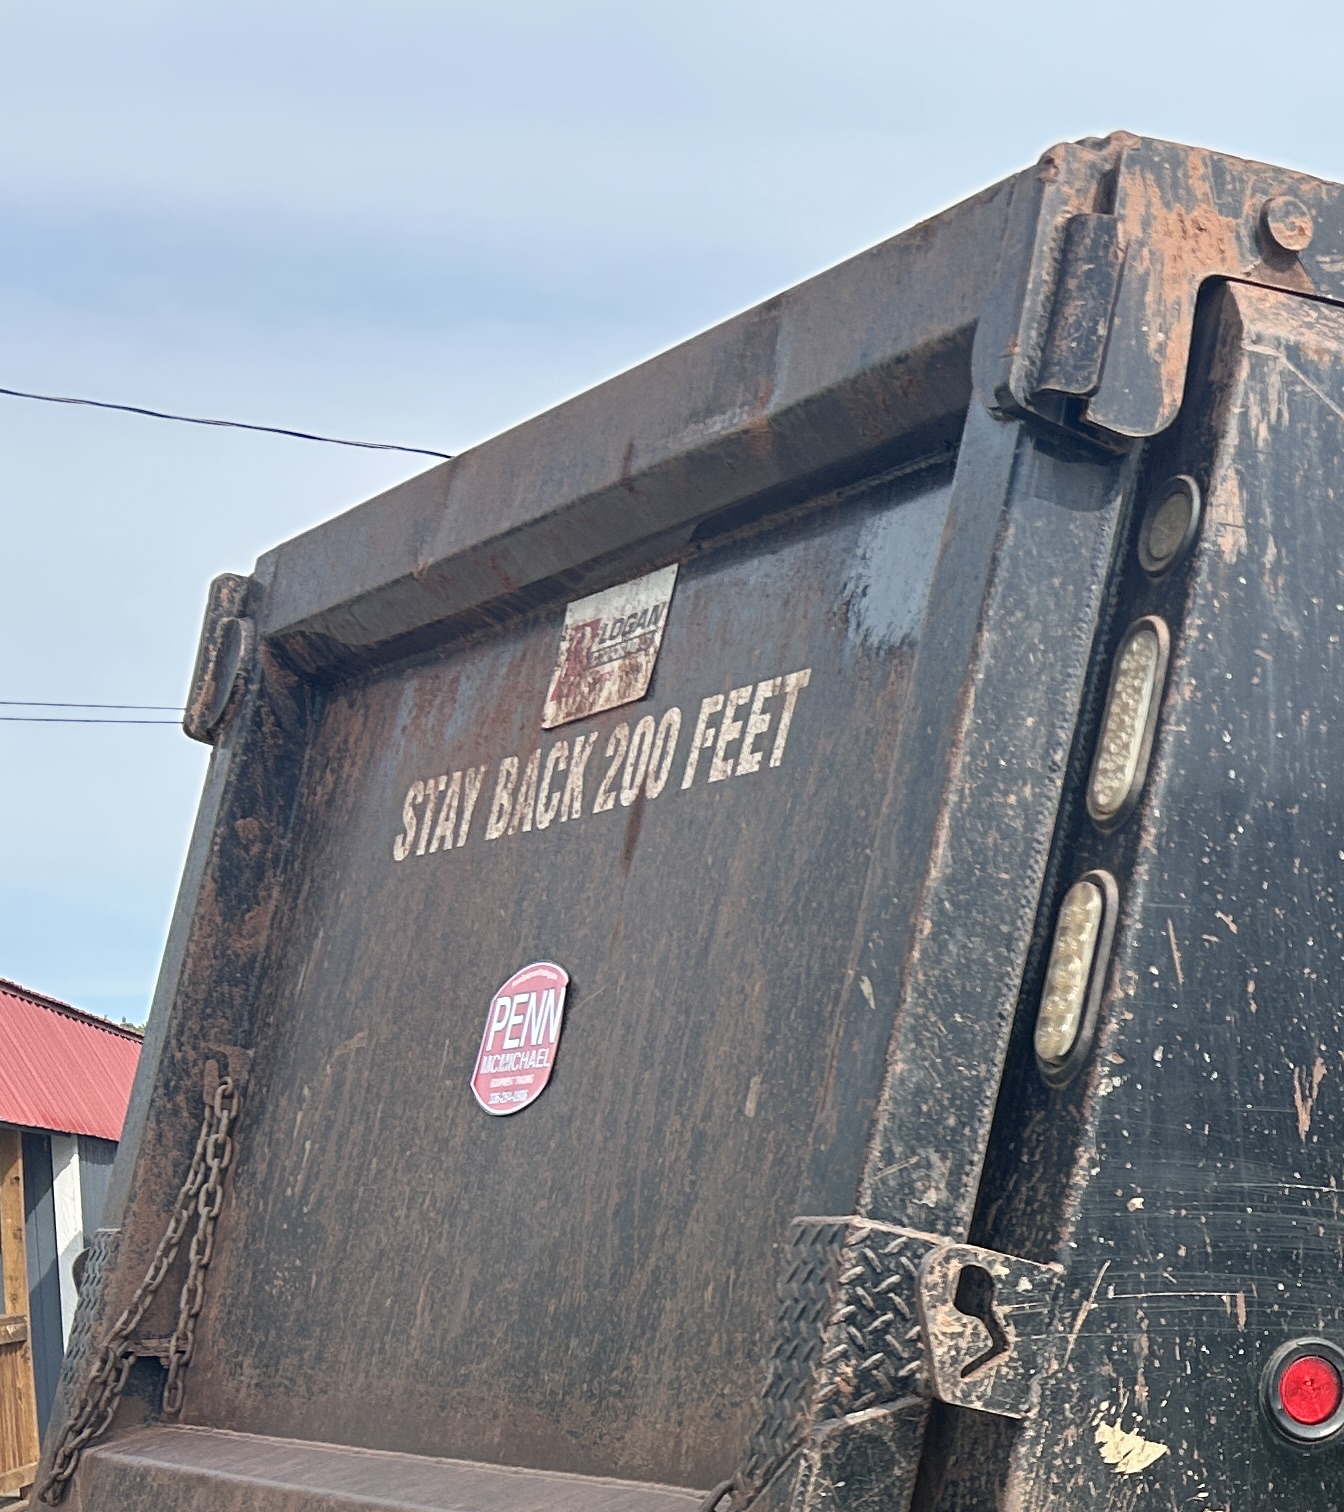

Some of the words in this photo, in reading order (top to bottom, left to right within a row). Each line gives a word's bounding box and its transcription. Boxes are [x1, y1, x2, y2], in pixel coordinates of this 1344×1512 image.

[599, 602, 667, 643] LOGAN
[394, 763, 488, 861] STAY
[485, 732, 598, 842] BACK
[593, 707, 682, 814] 200
[681, 668, 812, 790] FEET
[486, 987, 567, 1051] PENN
